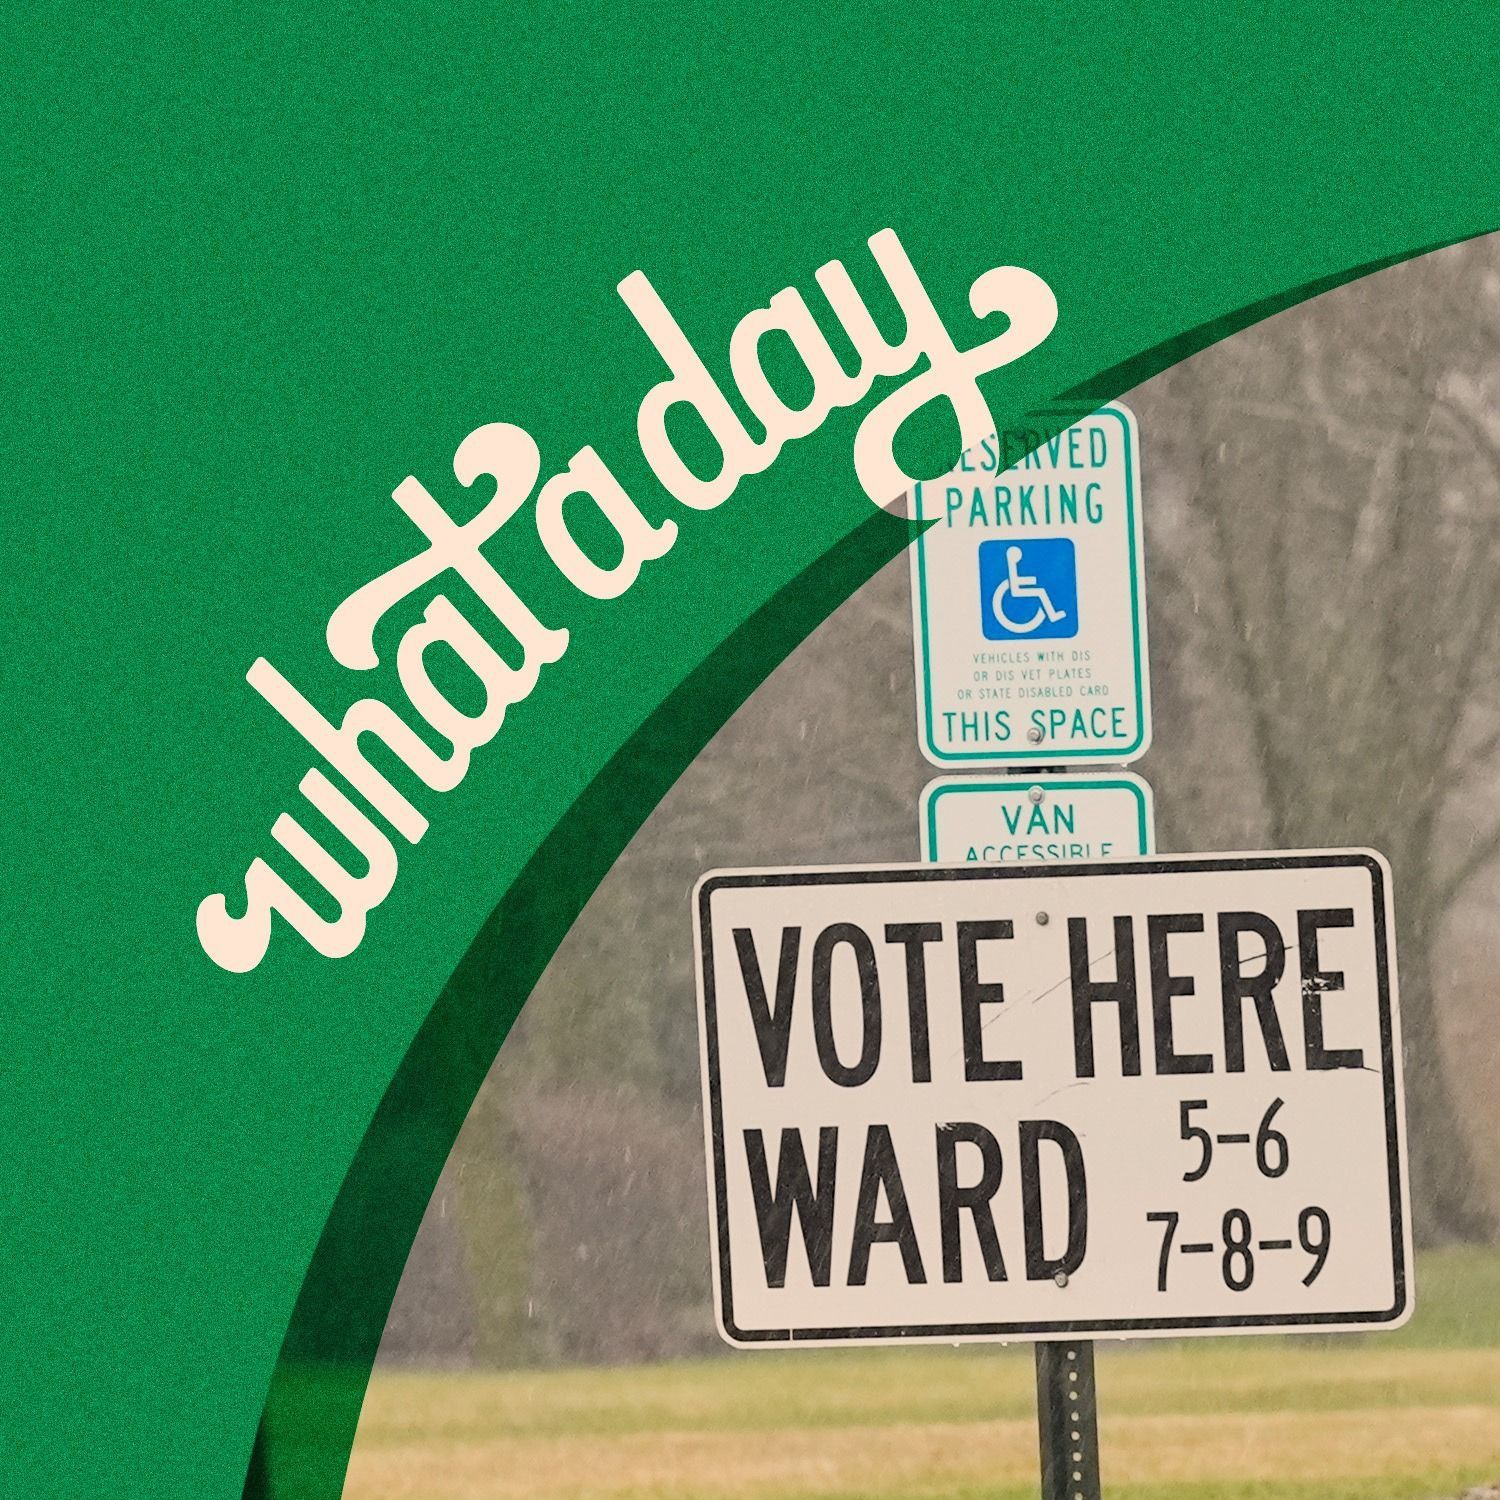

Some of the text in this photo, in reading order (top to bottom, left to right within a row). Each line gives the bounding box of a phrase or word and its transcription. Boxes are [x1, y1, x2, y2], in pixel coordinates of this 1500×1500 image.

[946, 483, 1103, 528] PARKING
[972, 650, 1091, 664] VEHICLES WITH DIS
[973, 668, 1092, 682] OR DIS VET PLATES
[957, 684, 1109, 700] OR STATE DISABLED CARD
[942, 707, 1127, 742] THIS SPACE
[1001, 803, 1075, 835] VAN
[731, 908, 1365, 1089] VOTE HERE
[1178, 1097, 1290, 1183] 5-6
[742, 1119, 1089, 1289] WARD
[1146, 1205, 1332, 1293] 7-8-9
